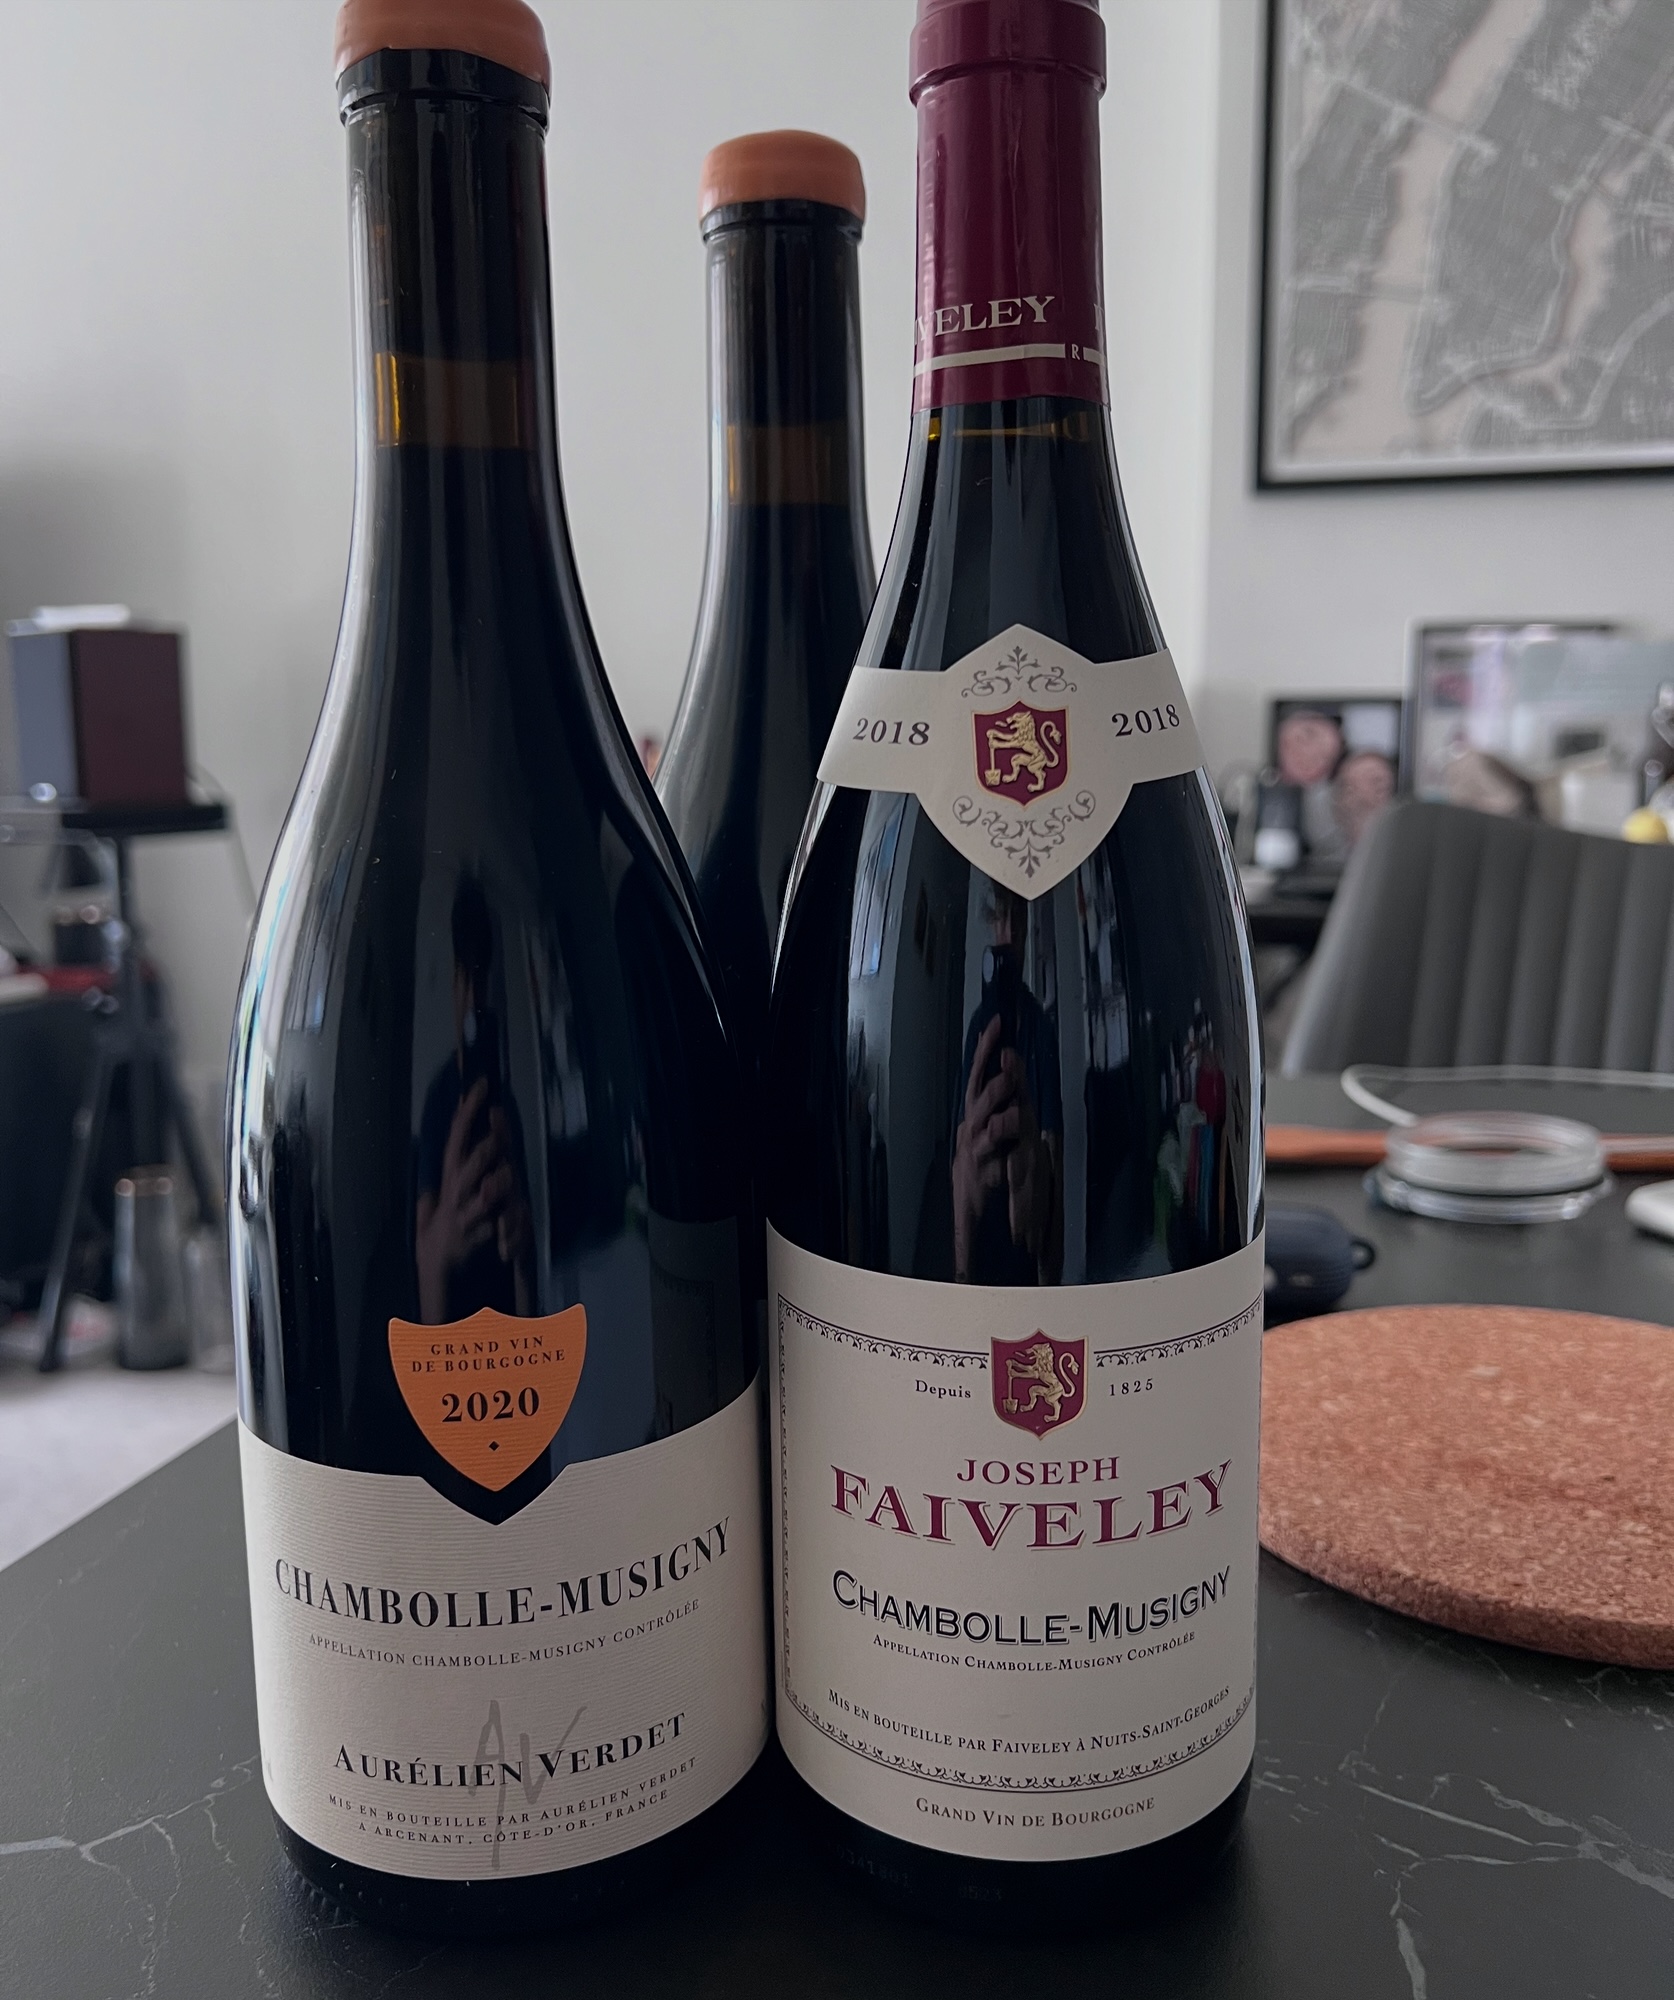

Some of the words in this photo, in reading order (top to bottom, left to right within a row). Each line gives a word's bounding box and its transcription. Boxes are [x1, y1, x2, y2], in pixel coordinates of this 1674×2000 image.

[1072, 343, 1081, 360] R
[852, 717, 930, 746] 2018
[1110, 703, 1181, 738] 2018
[411, 1360, 436, 1373] DE
[444, 1349, 566, 1372] BOURGOGNE
[430, 1340, 500, 1356] GRAND
[509, 1335, 545, 1350] VIN
[441, 1386, 540, 1423] 2020
[914, 1379, 972, 1399] Depuis
[1109, 1377, 1154, 1397] 1825
[956, 1456, 1120, 1485] JOSEPH
[829, 1458, 1232, 1552] FAIVELEY
[275, 1516, 730, 1628] CHAMBOLLE-MUSIGNY
[832, 1565, 1231, 1646] CHAMBOLLE-MUSIGNY
[309, 1633, 406, 1665] APPELLATION
[412, 1635, 607, 1668] CHAMBOLLE-MUSIGNY
[612, 1599, 700, 1643] CONTRÔLÉE
[873, 1633, 960, 1666] APPELLATION
[964, 1654, 1124, 1672] CHAMBOLLE-MUSIGNY
[1127, 1631, 1196, 1662] CONTRÔLÉE
[828, 1688, 850, 1712] MIS
[853, 1704, 870, 1721] EN
[873, 1713, 953, 1746] BOUTEILLE
[957, 1736, 987, 1751] PAR
[991, 1738, 1071, 1754] FAIVELEY
[1076, 1737, 1086, 1751] À
[1090, 1686, 1230, 1750] NUITS-SAINT-GEORGES
[334, 1744, 524, 1787] AURÉLIEN
[535, 1712, 686, 1779] VERDET
[328, 1793, 352, 1811] MIS
[359, 1804, 378, 1818] EN
[386, 1810, 487, 1828] BOUTEILLE
[497, 1812, 530, 1826] PAR
[540, 1788, 631, 1821] AURÉLIEN
[638, 1756, 697, 1792] VERDET
[604, 1789, 669, 1822] FRANCE
[915, 1797, 977, 1823] GRAND
[982, 1810, 1015, 1827] VIN
[1022, 1815, 1046, 1828] DE
[1051, 1797, 1155, 1828] BOURGOGNE
